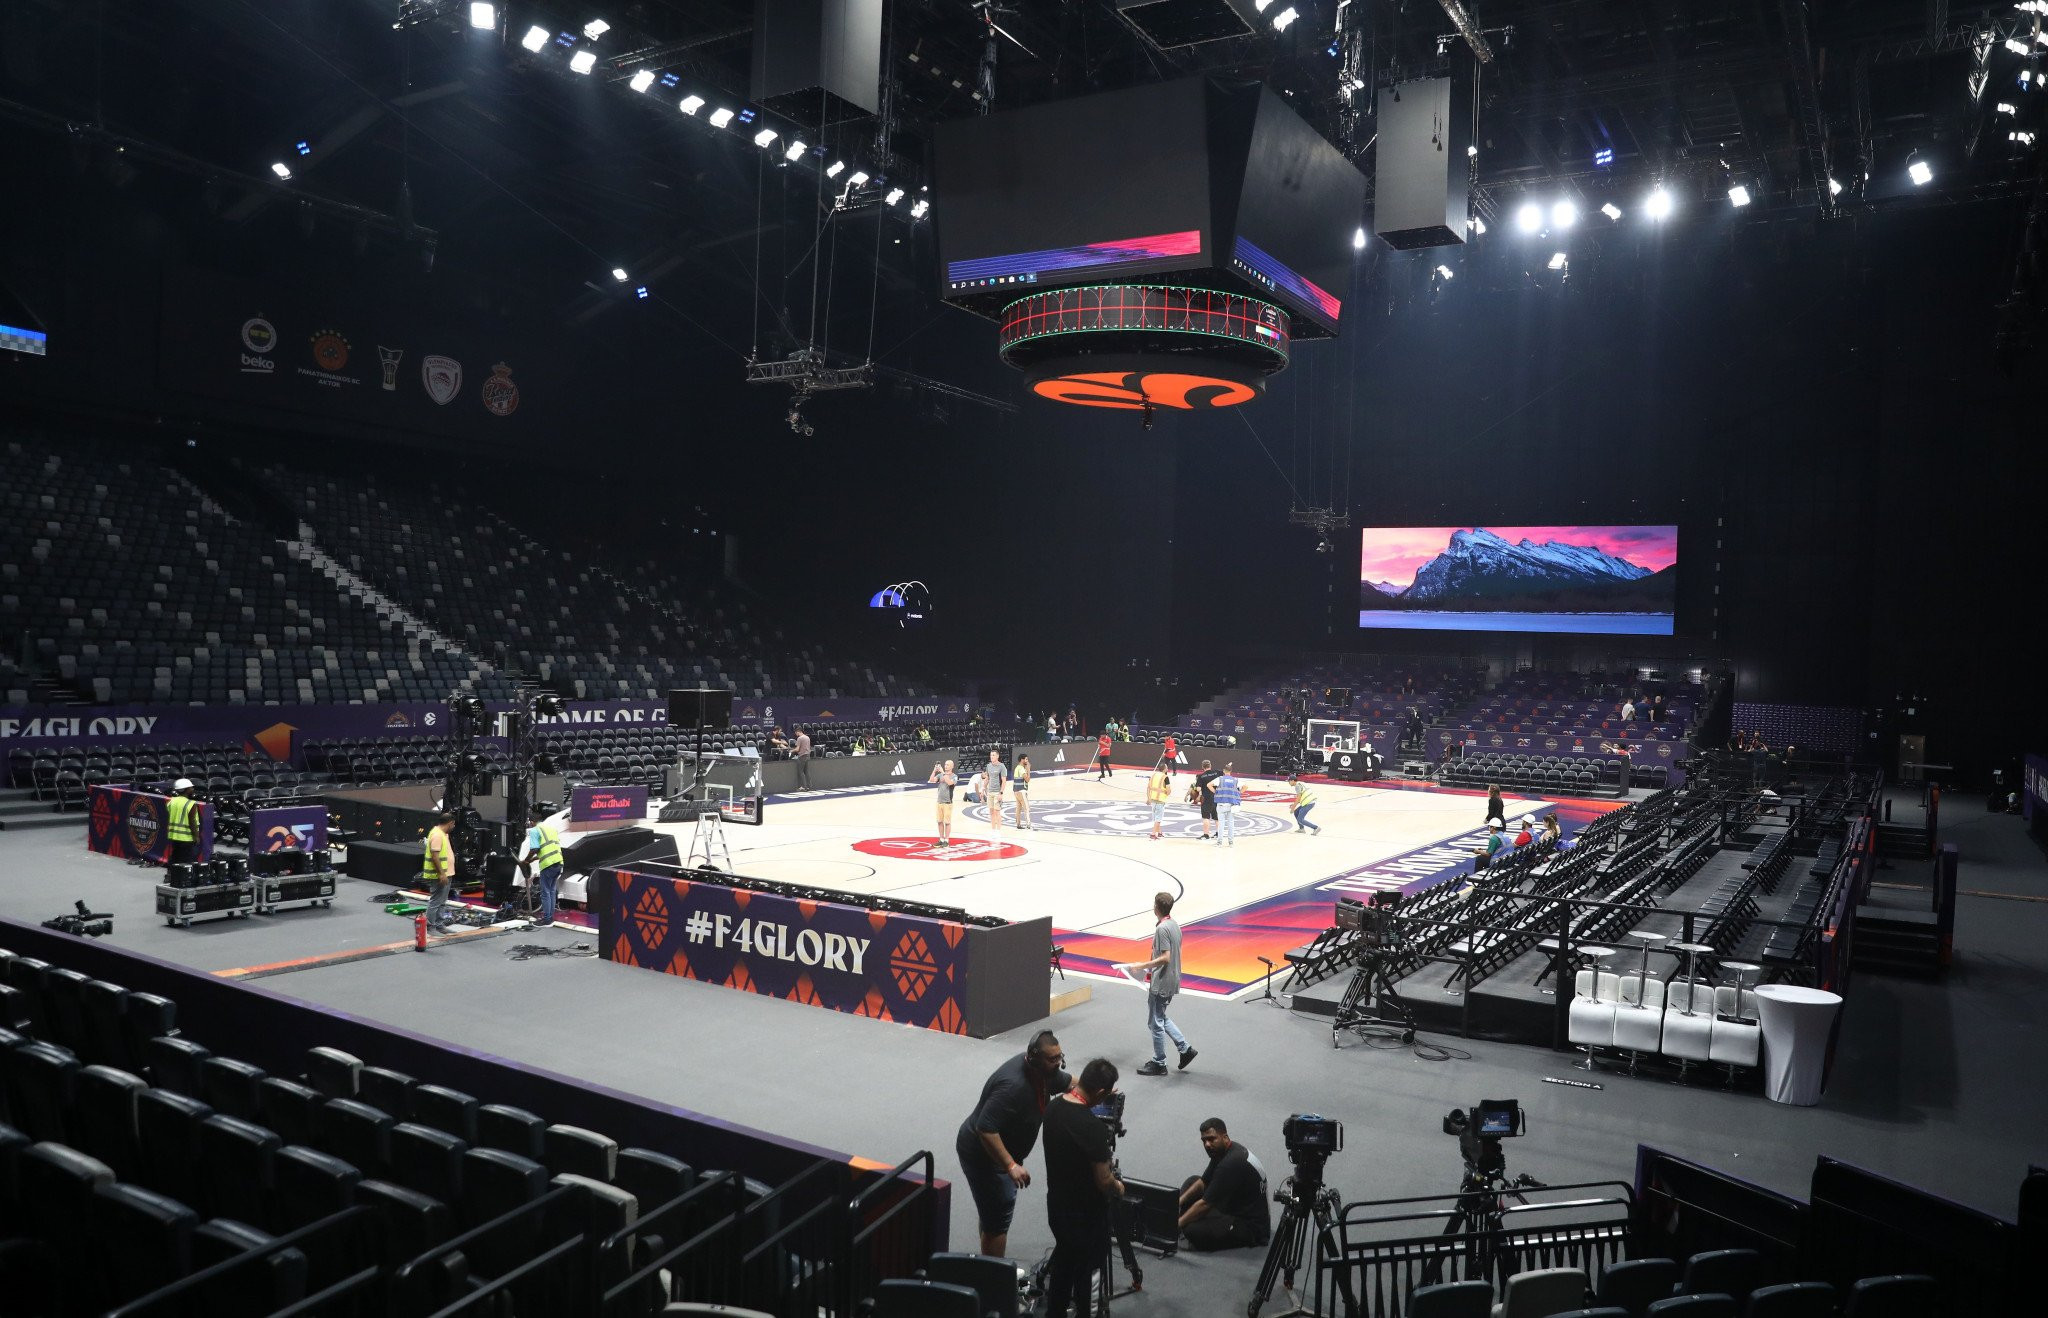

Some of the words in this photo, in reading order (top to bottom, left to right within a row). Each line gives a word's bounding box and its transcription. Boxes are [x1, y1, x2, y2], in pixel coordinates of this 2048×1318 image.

[241, 353, 275, 369] beko
[591, 799, 606, 809] abu
[607, 798, 631, 808] dhabi
[1314, 870, 1424, 893] THE
[1374, 846, 1479, 875] HOME
[685, 909, 871, 975] #F4GLORY
[1545, 1077, 1591, 1088] SECTION
